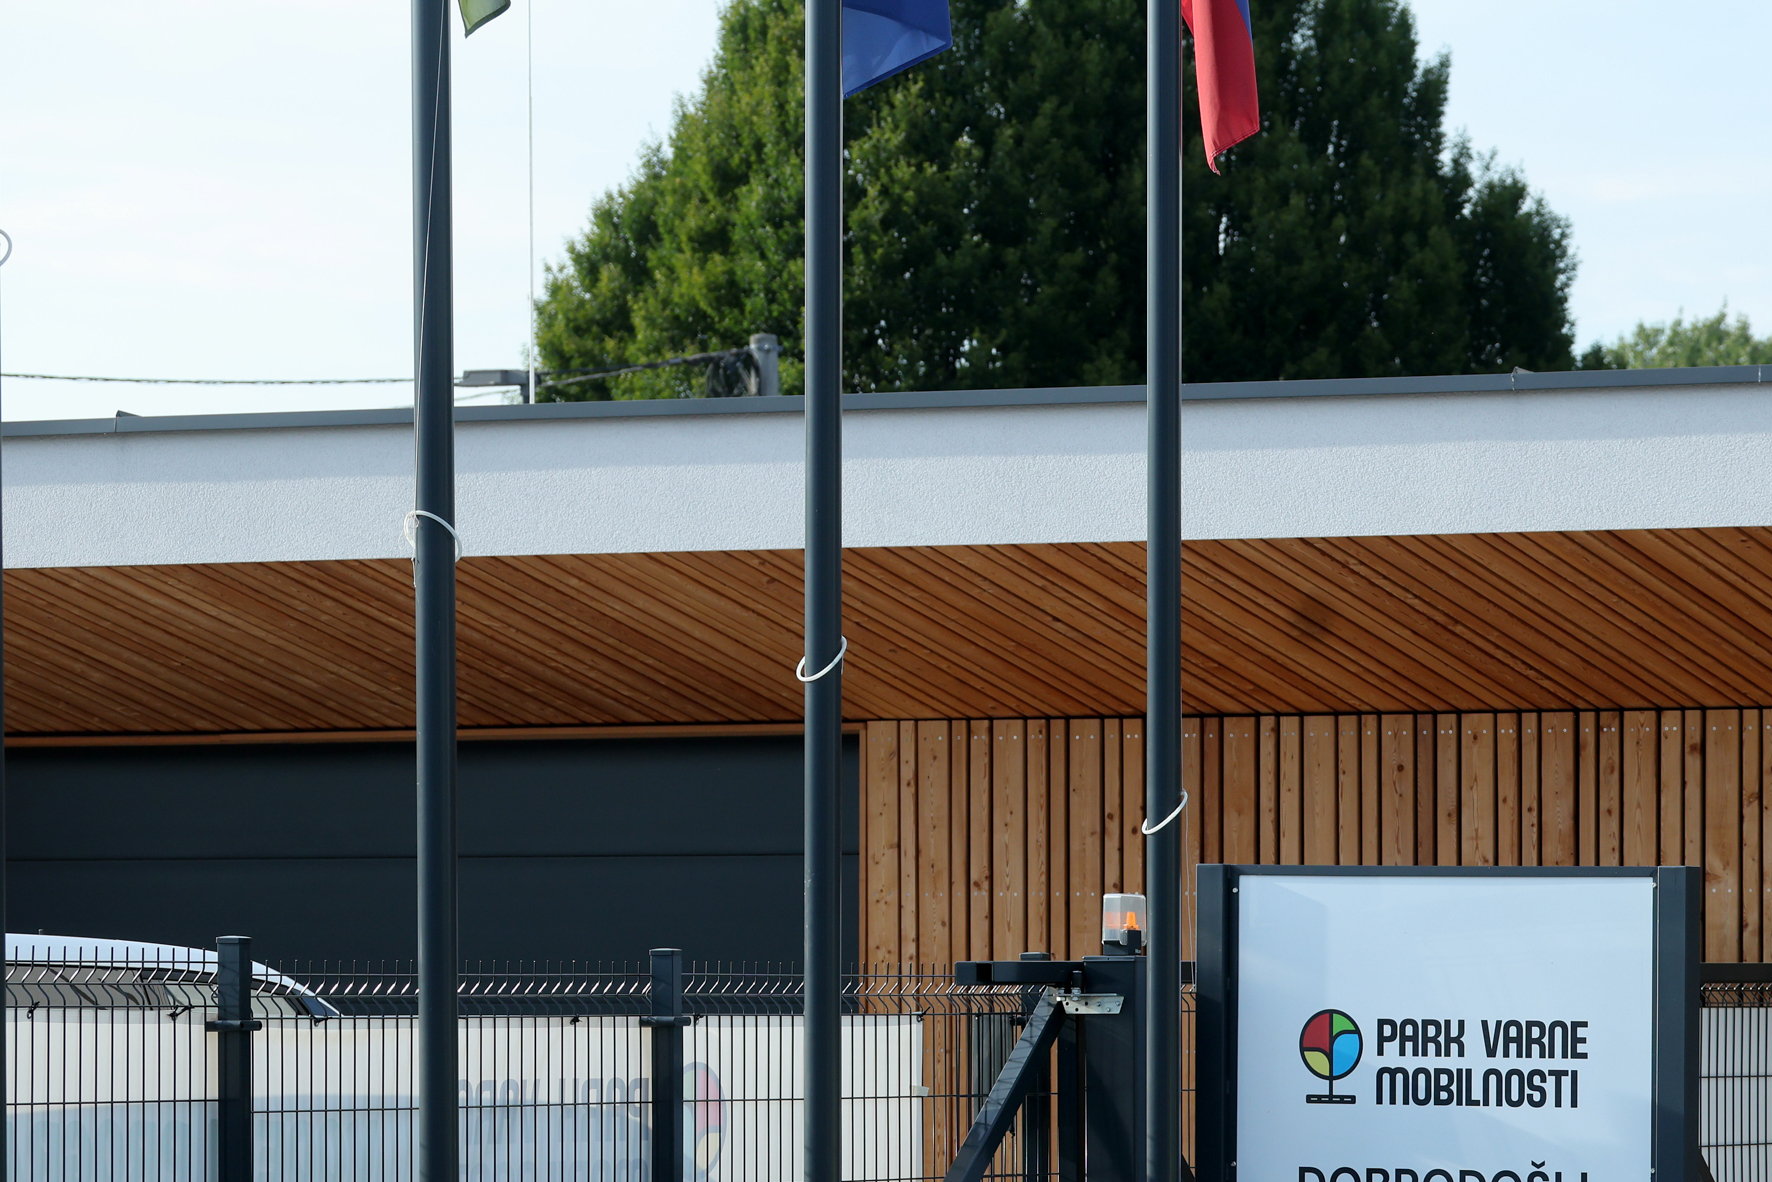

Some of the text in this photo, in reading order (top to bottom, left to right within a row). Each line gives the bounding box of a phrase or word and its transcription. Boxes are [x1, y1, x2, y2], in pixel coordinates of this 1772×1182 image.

[1376, 1018, 1589, 1060] PARK VARNE
[1375, 1066, 1578, 1109] MOBILNOSTI
